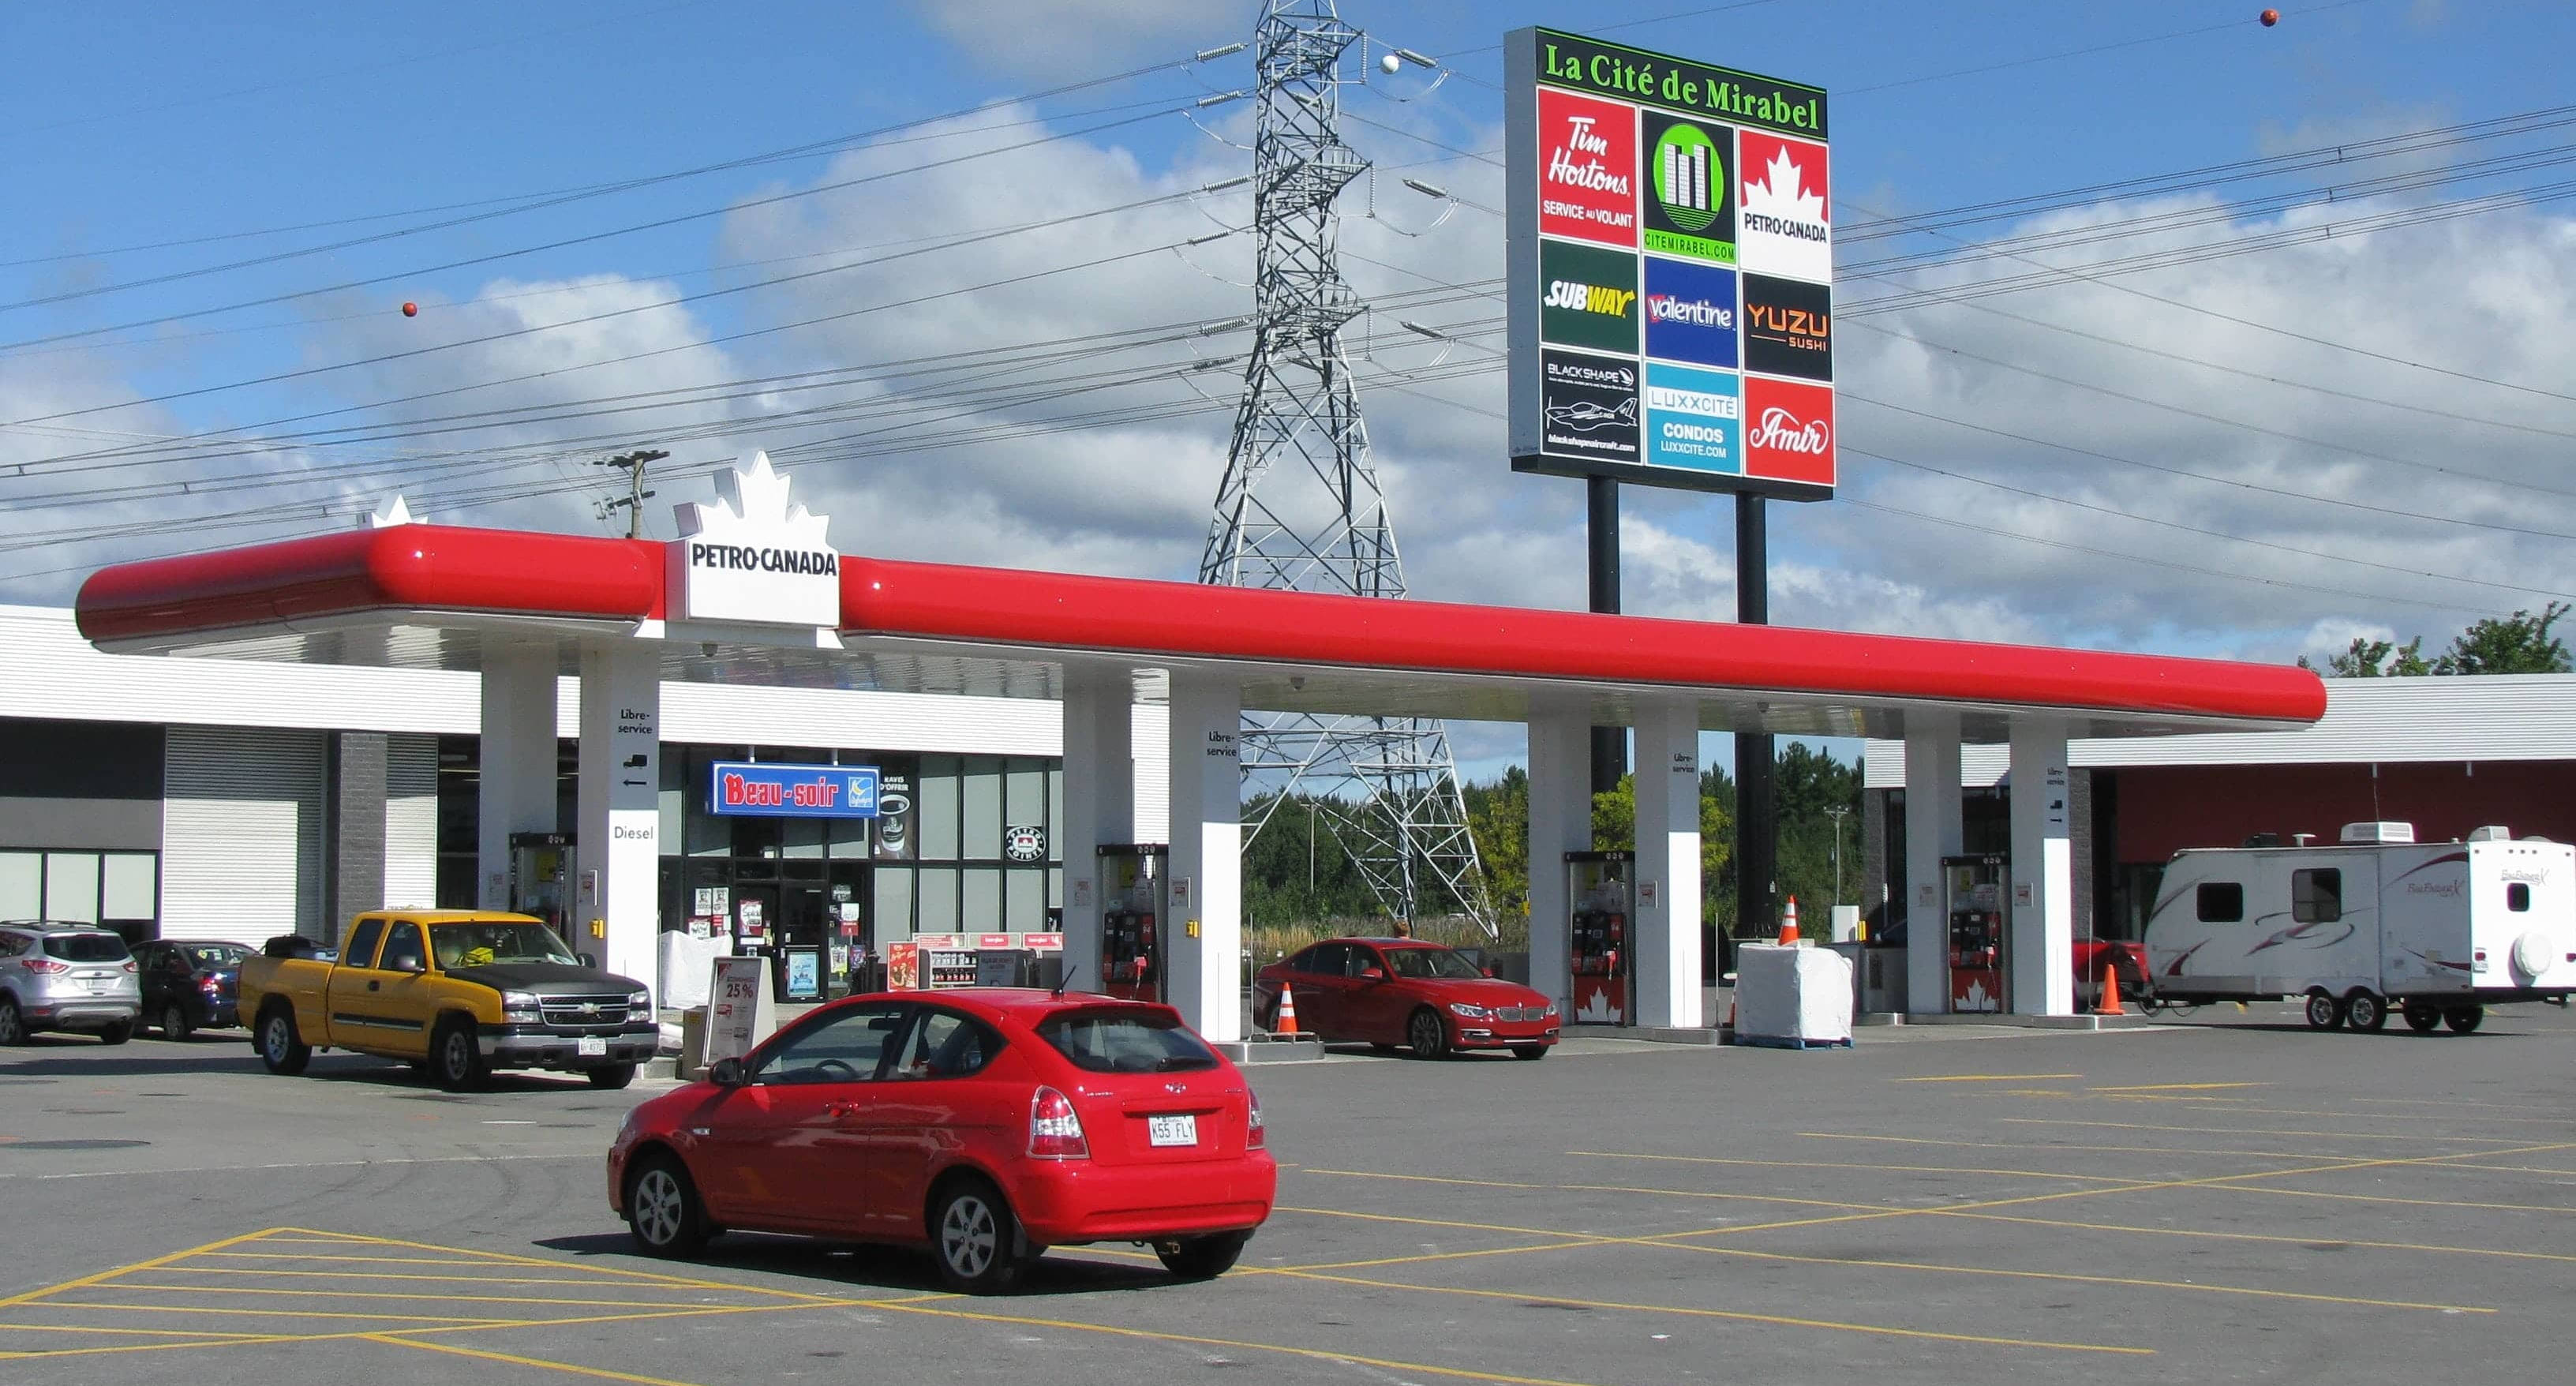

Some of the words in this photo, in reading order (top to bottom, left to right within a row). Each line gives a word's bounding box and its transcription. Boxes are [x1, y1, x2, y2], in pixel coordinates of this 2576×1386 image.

[1545, 43, 1582, 81] La
[1589, 54, 1654, 96] Cité
[1662, 69, 1698, 105] de
[1705, 78, 1819, 129] Mirabel
[1568, 116, 1606, 156] Tim
[1548, 146, 1629, 197] Hortons
[1543, 200, 1585, 221] SERVICE
[1586, 210, 1596, 219] AU
[1596, 208, 1633, 228] VOLANT
[1645, 233, 1735, 260] CITEMIRABEL.COM
[1544, 280, 1636, 318] SUBWAY
[1747, 303, 1828, 338] YUZU
[1788, 336, 1827, 352] SUSHI
[1651, 390, 1735, 416] LUXXCITÉ
[1663, 422, 1724, 444] CONDOS
[1750, 407, 1829, 455] Amir
[1661, 440, 1727, 459] LUXXCITE.COM
[620, 709, 650, 720] Libre-
[618, 724, 653, 734] service
[1208, 731, 1234, 743] Libre-
[1207, 746, 1237, 757] service
[724, 773, 838, 807] Beau-soir
[614, 826, 653, 840] Diesel
[726, 983, 740, 998] 25
[1152, 1122, 1170, 1139] K55
[1176, 1122, 1193, 1138] FLY
